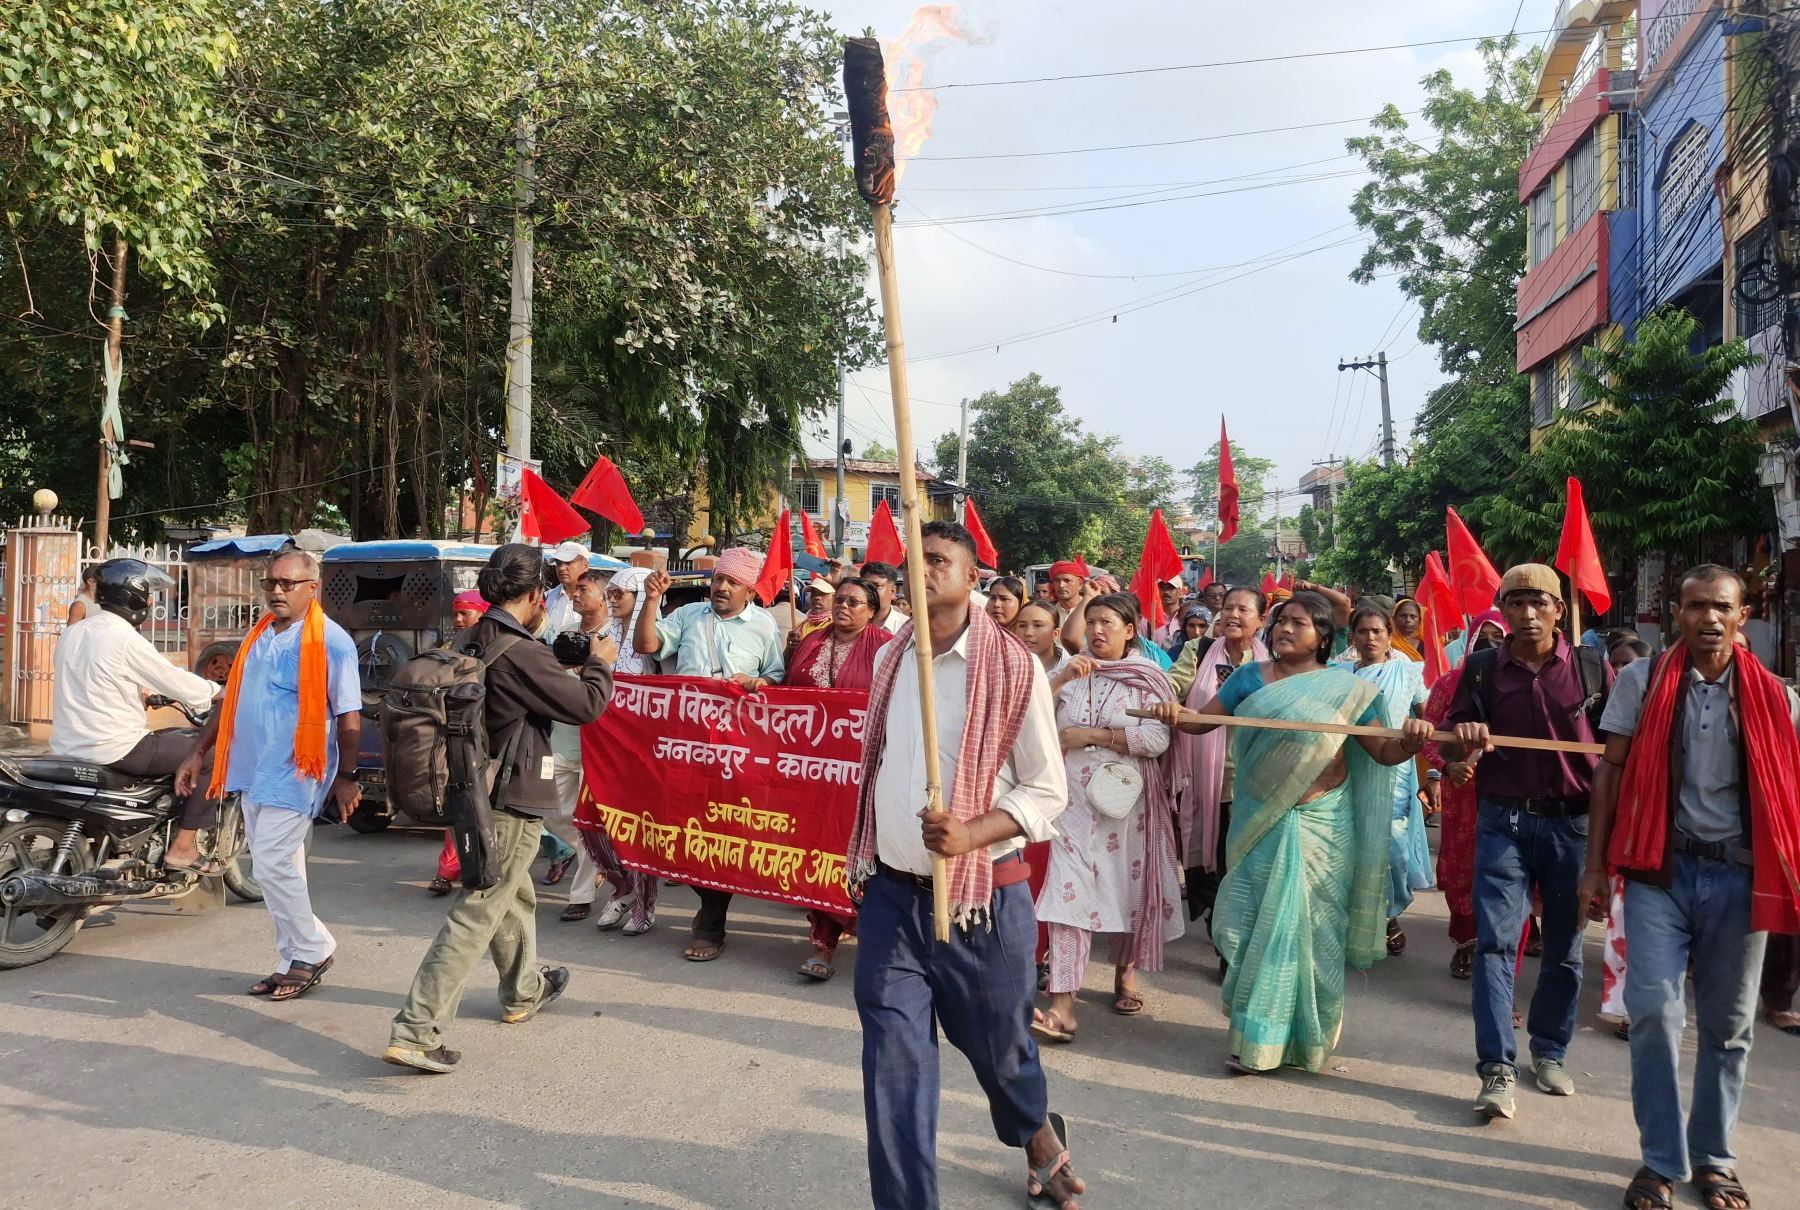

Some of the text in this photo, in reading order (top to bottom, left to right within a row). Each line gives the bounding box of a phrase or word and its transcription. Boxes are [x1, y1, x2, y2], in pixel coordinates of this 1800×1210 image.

[610, 680, 675, 720] ब्याज
[832, 709, 867, 743] न्य
[653, 737, 750, 779] जनकपुर
[683, 817, 748, 873] किसान
[805, 848, 852, 898] आन्द
